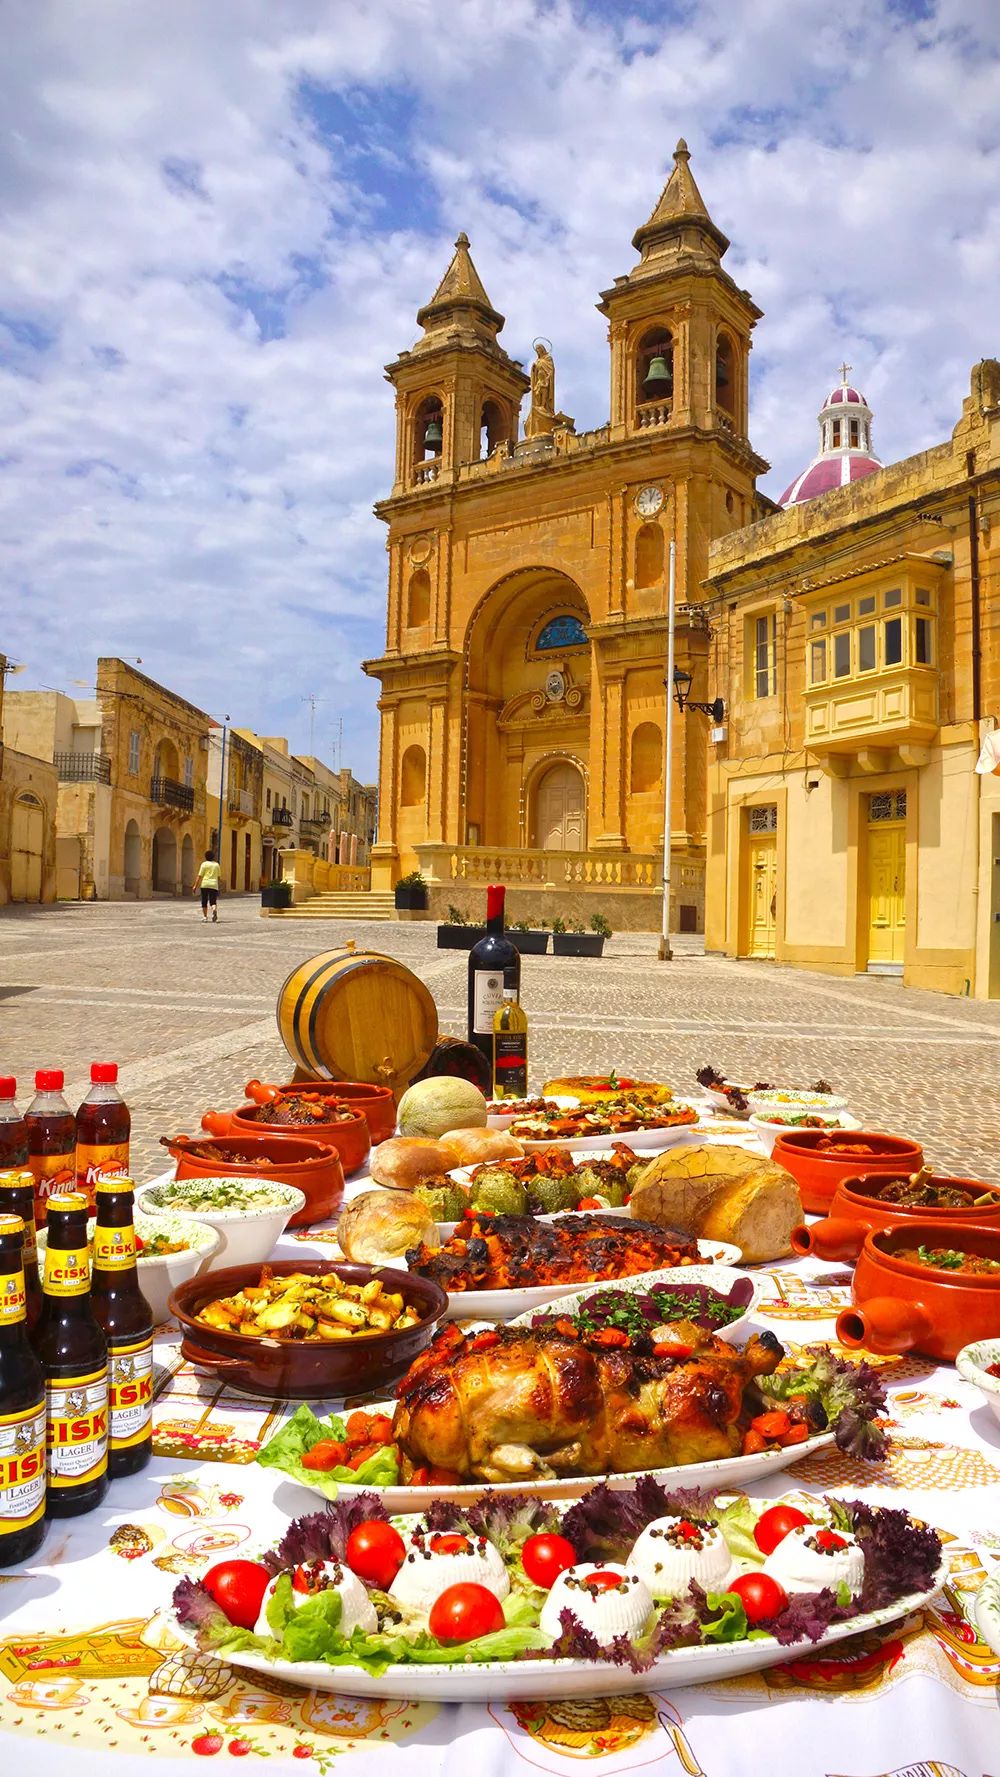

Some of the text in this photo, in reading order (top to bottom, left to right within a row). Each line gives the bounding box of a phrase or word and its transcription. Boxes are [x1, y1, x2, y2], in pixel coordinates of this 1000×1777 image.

[38, 1176, 77, 1197] Kinni
[101, 1243, 133, 1255] CISK
[53, 1266, 87, 1279] CISK
[0, 1290, 25, 1306] ISK
[108, 1377, 152, 1407] ISK
[110, 1408, 140, 1420] LAGER
[60, 1444, 92, 1457] LAGER
[10, 1480, 39, 1499] LAGER
